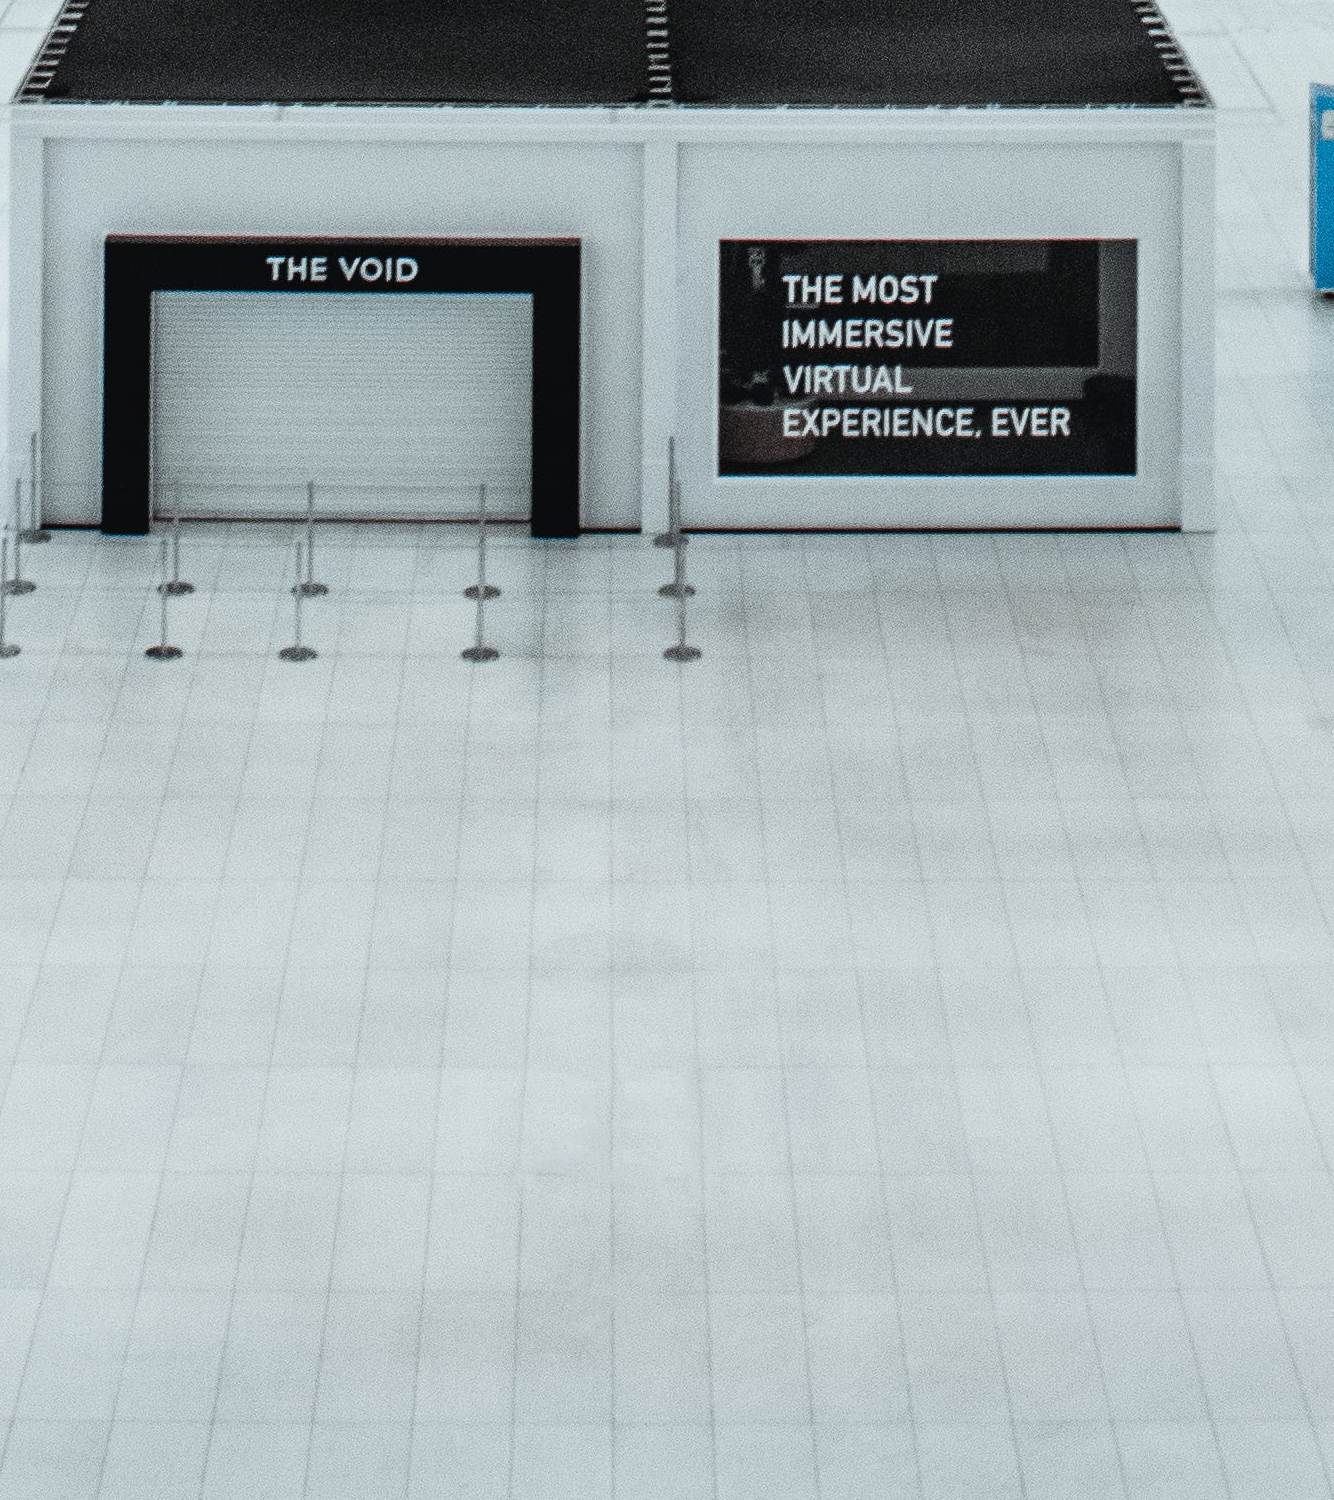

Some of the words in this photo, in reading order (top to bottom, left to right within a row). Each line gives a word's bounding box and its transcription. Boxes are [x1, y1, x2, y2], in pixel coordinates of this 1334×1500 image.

[266, 257, 328, 282] THE
[338, 257, 418, 282] VOID
[782, 274, 843, 304] THE
[852, 274, 939, 304] MOST
[782, 318, 953, 348] IMMERSIVE
[783, 364, 913, 394] VIRTUAL
[782, 407, 982, 438] EXPERIENCE,
[991, 407, 1071, 437] EVER
